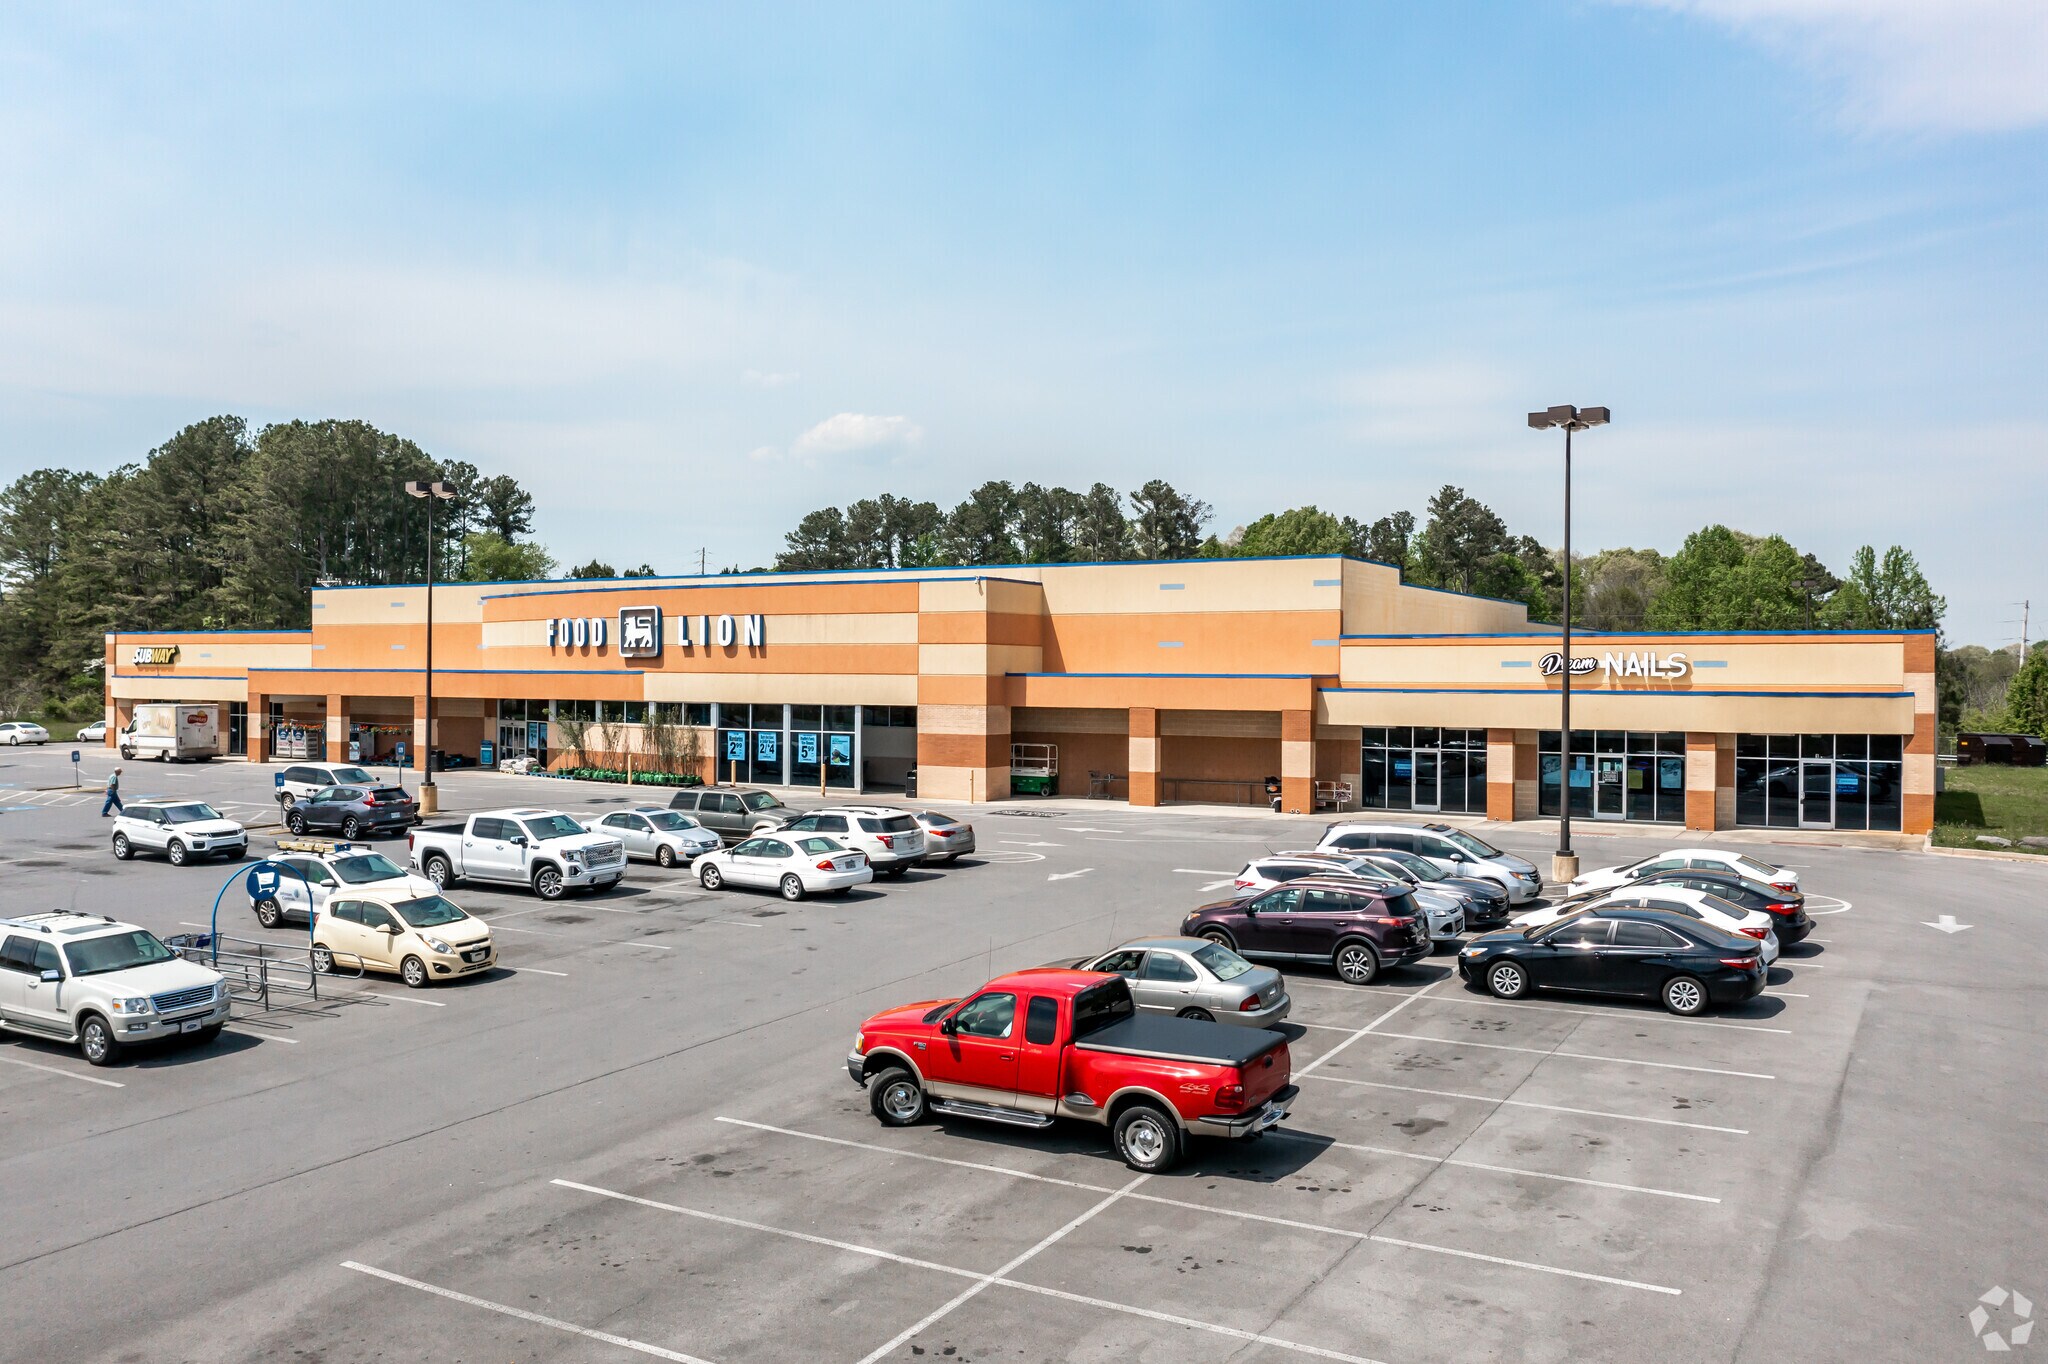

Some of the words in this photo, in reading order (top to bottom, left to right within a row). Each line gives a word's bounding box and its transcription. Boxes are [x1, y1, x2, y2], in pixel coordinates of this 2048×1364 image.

[547, 618, 608, 647] FOOD
[678, 615, 765, 647] LION
[132, 647, 176, 664] SUBWAY
[1605, 652, 1687, 678] NAILS
